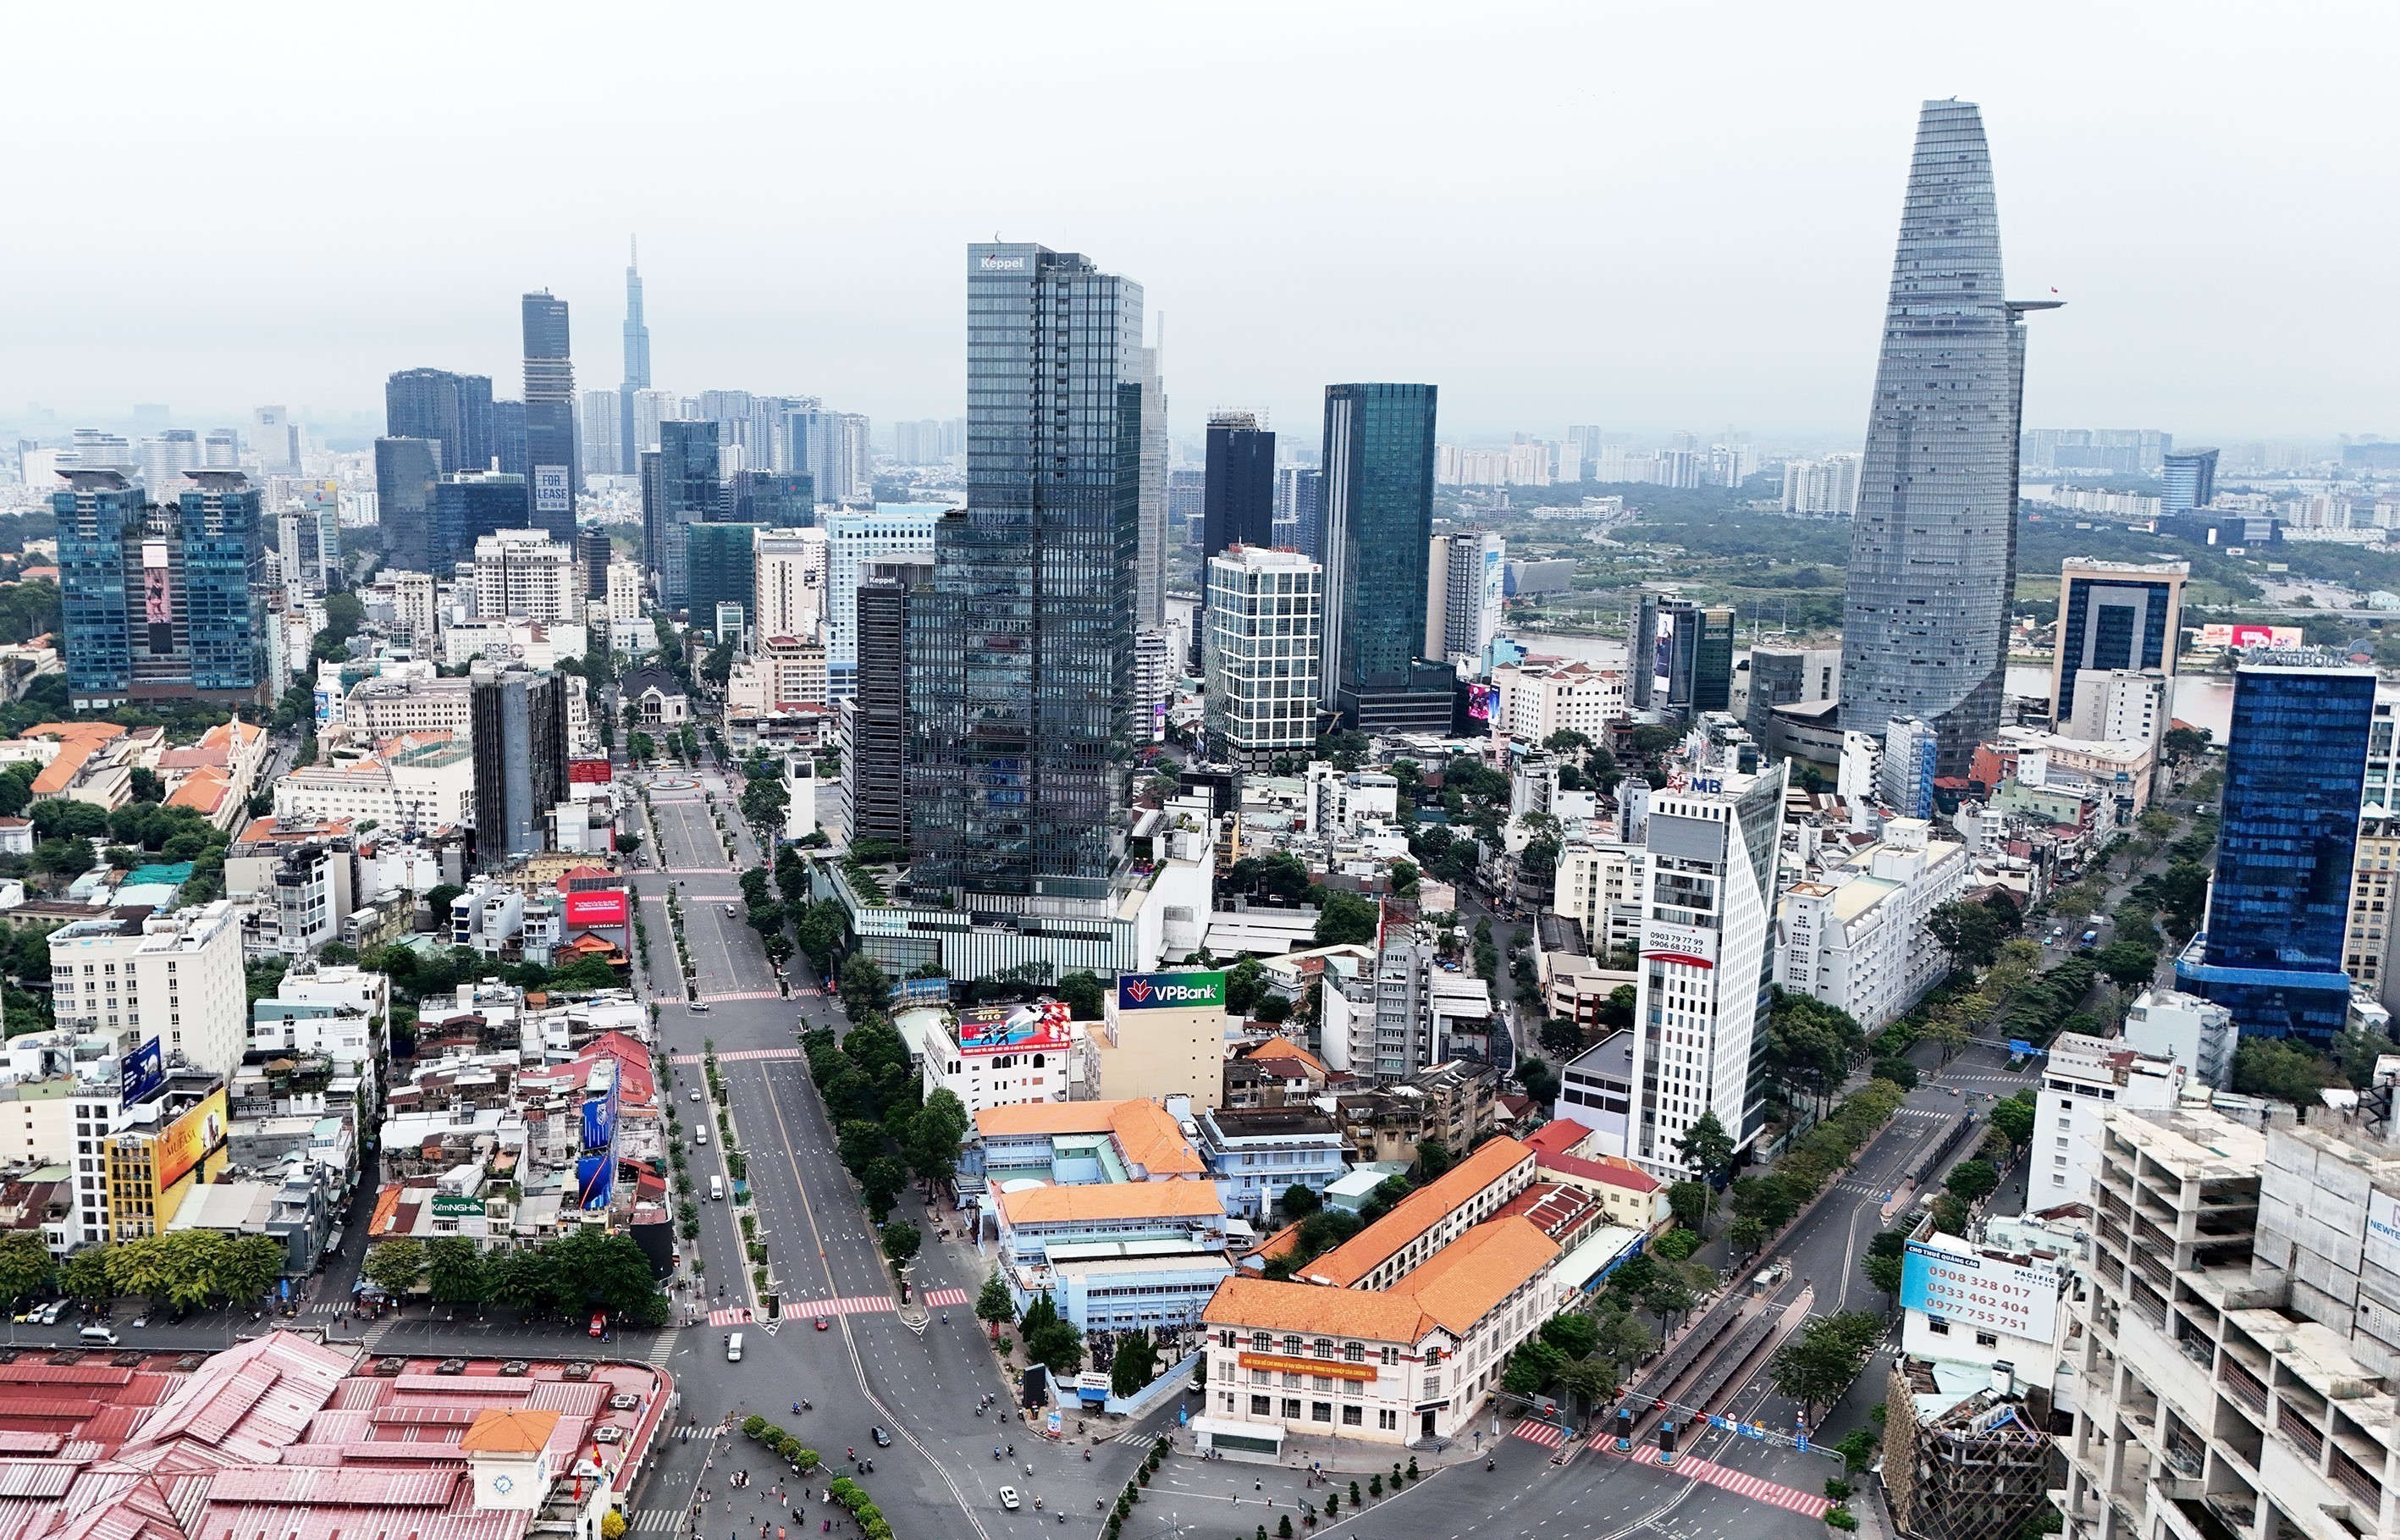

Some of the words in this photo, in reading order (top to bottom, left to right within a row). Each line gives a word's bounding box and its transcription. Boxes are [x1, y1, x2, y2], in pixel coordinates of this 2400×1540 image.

[981, 257, 1023, 270] Keppel
[543, 474, 560, 486] FOR
[538, 488, 567, 500] LEASE
[869, 576, 896, 585] Keppel
[1691, 777, 1721, 794] MB
[1650, 931, 1669, 941] 0903
[1650, 940, 1669, 948] 0906
[1155, 984, 1217, 1001] VPBank
[167, 1129, 196, 1159] MUFASA
[1923, 1249, 1940, 1259] THUÊ
[1941, 1253, 1964, 1265] QUẢNG
[1965, 1257, 1978, 1267] CÁO
[1929, 1267, 1966, 1283] 0908
[1970, 1276, 1998, 1291] 328
[2002, 1284, 2031, 1298] 017
[2014, 1269, 2055, 1284] PACIFIC
[1928, 1283, 1964, 1300] 0933
[1968, 1293, 1996, 1307] 462
[2000, 1301, 2029, 1316] 404
[1926, 1298, 1963, 1314] 0977
[1967, 1308, 1995, 1322] 755
[2000, 1316, 2027, 1331] 751
